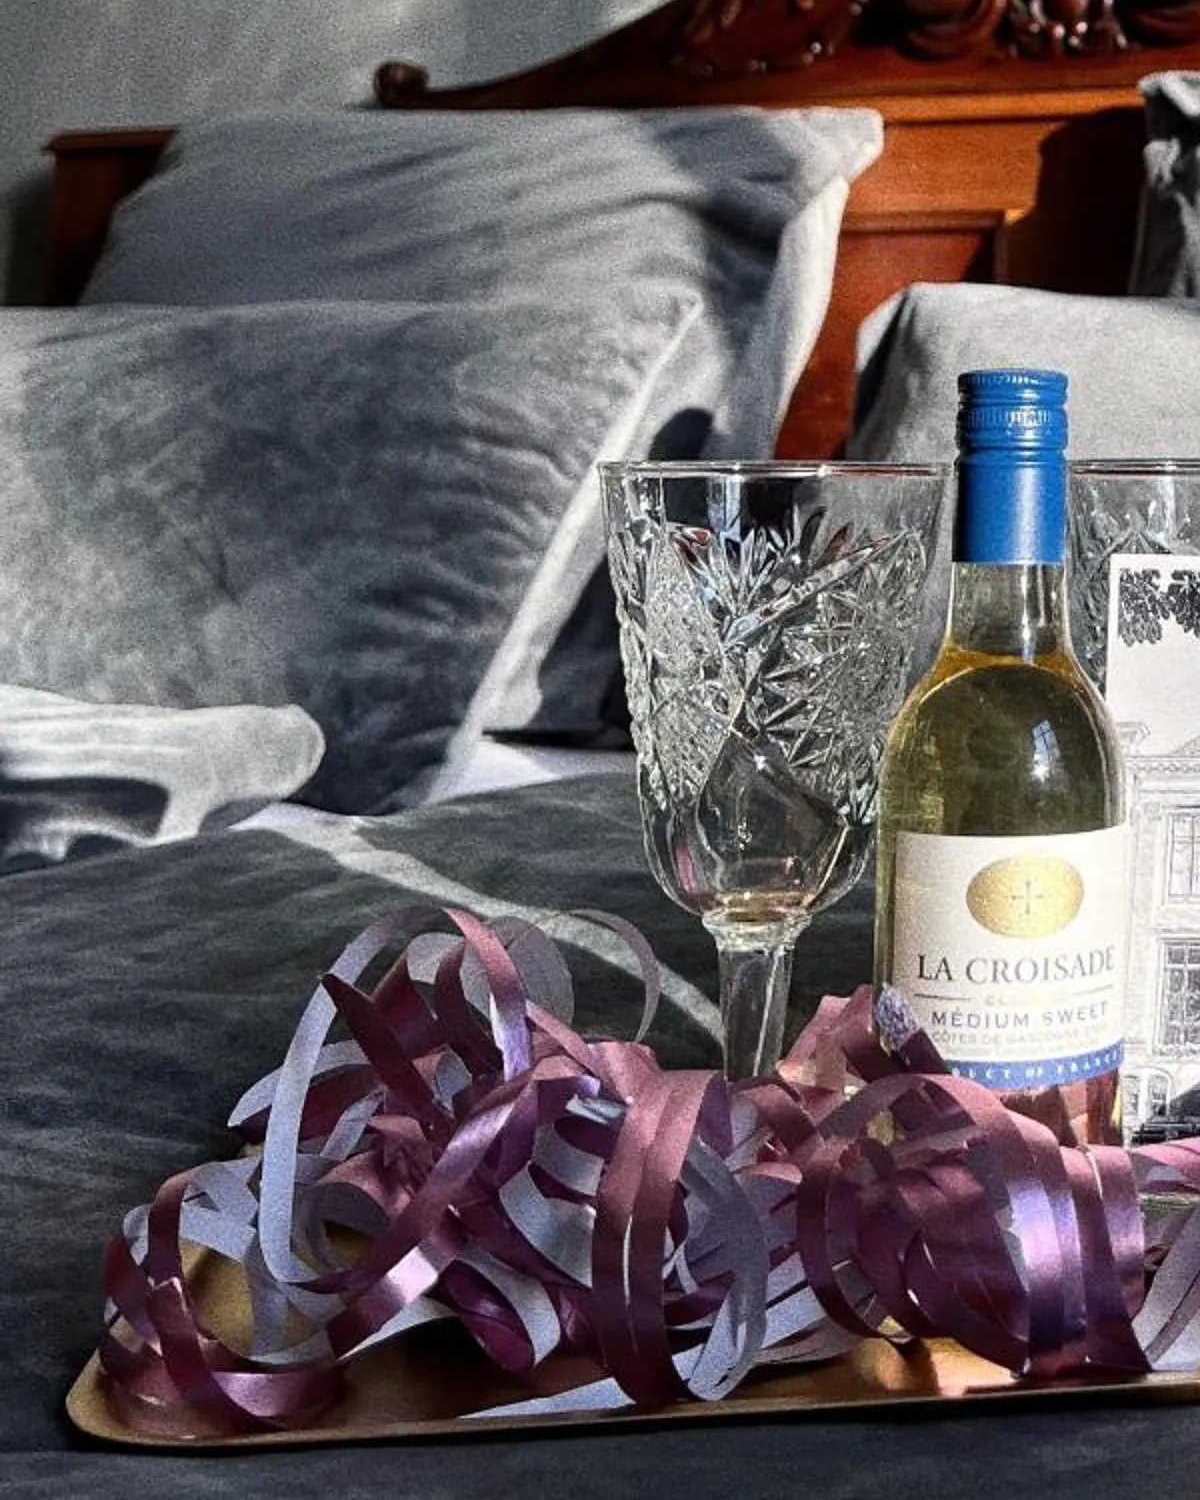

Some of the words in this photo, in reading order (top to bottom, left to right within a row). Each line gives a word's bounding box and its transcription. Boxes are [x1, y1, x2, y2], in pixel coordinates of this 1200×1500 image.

[917, 954, 953, 982] LA
[965, 946, 1116, 985] CROISADE
[1042, 1000, 1108, 1027] SWEET
